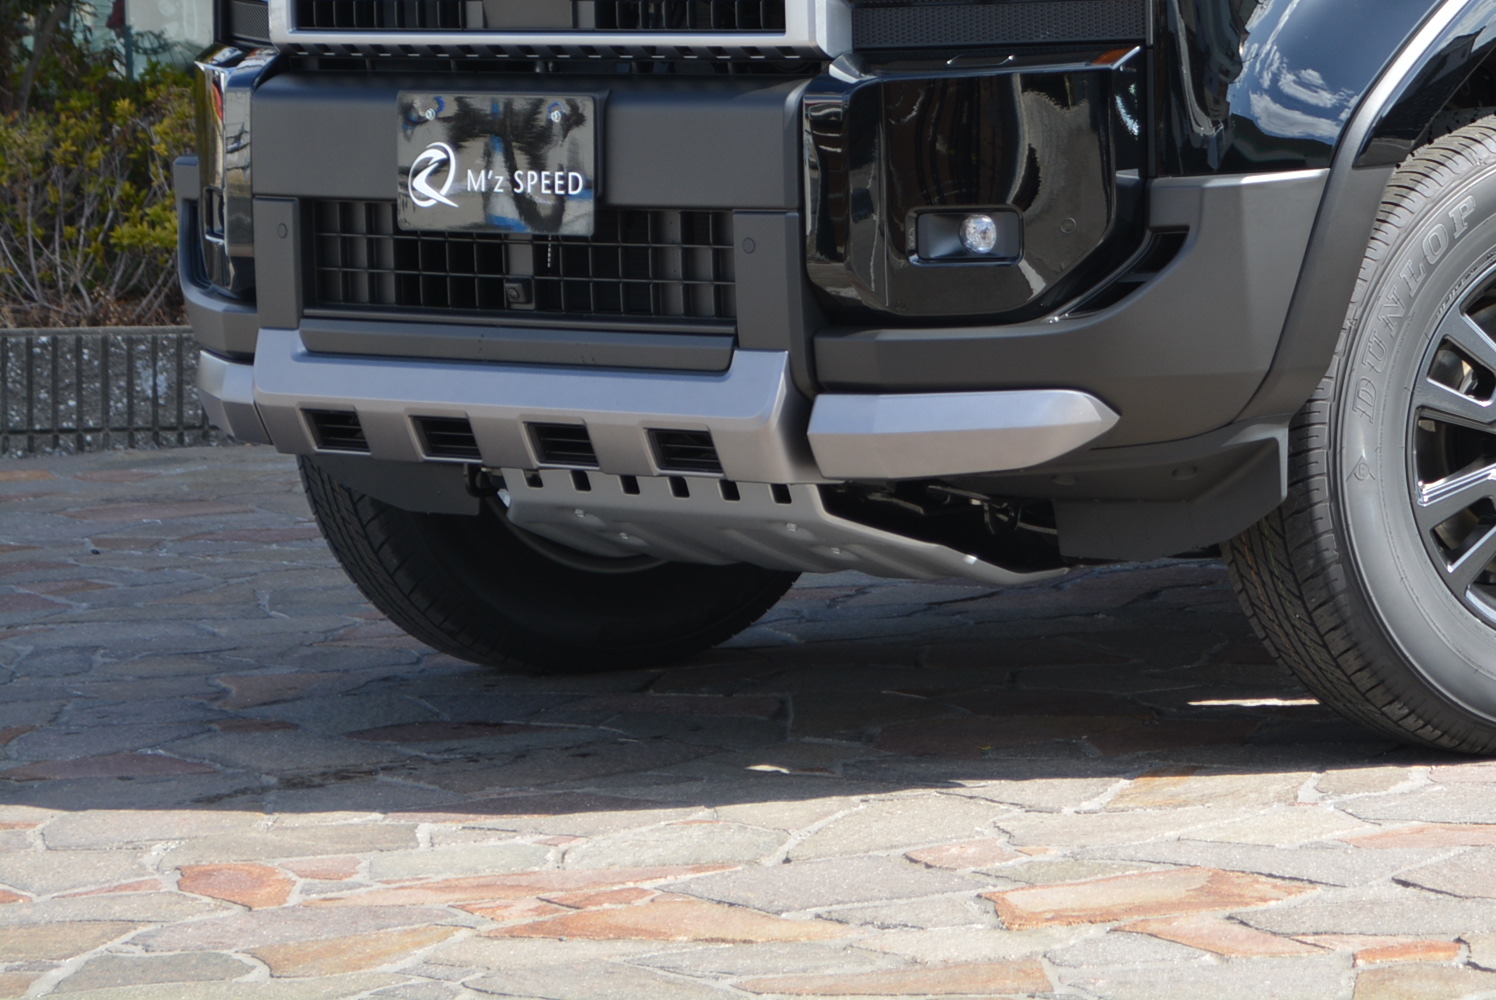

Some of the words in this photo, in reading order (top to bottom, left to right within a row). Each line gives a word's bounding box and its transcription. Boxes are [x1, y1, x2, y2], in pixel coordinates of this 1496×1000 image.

[466, 169, 504, 194] M'z
[513, 170, 583, 195] SPEED
[1353, 195, 1475, 423] DUNLOP
